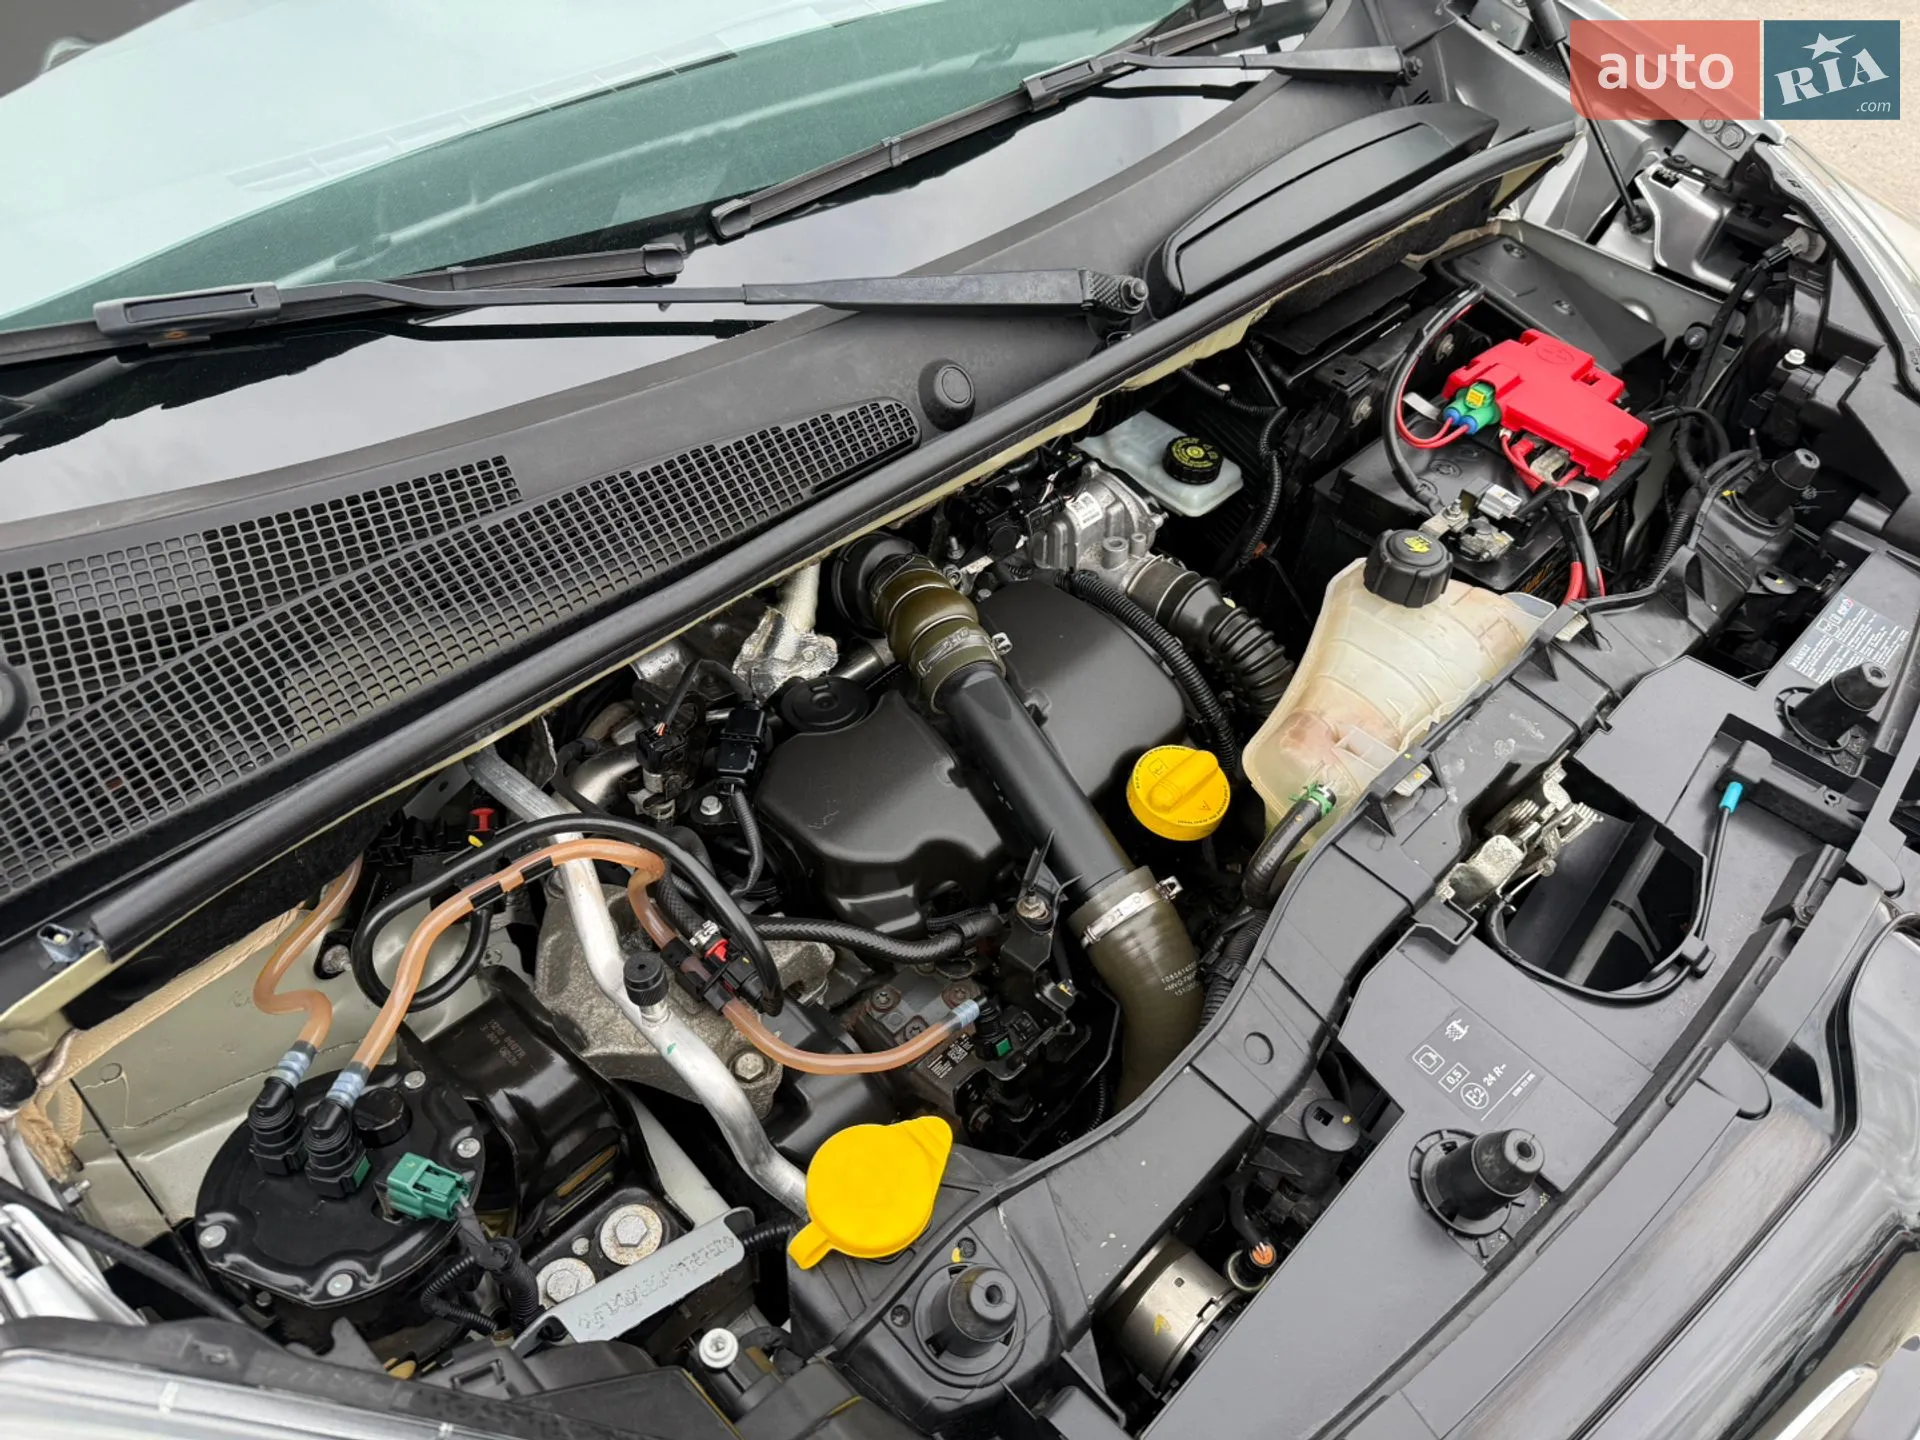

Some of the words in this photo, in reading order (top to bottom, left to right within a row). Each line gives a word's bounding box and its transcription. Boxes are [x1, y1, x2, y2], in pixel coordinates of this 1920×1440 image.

[1446, 1069, 1462, 1085] 0,5
[1464, 1086, 1485, 1107] E2
[1482, 1073, 1497, 1087] 24
